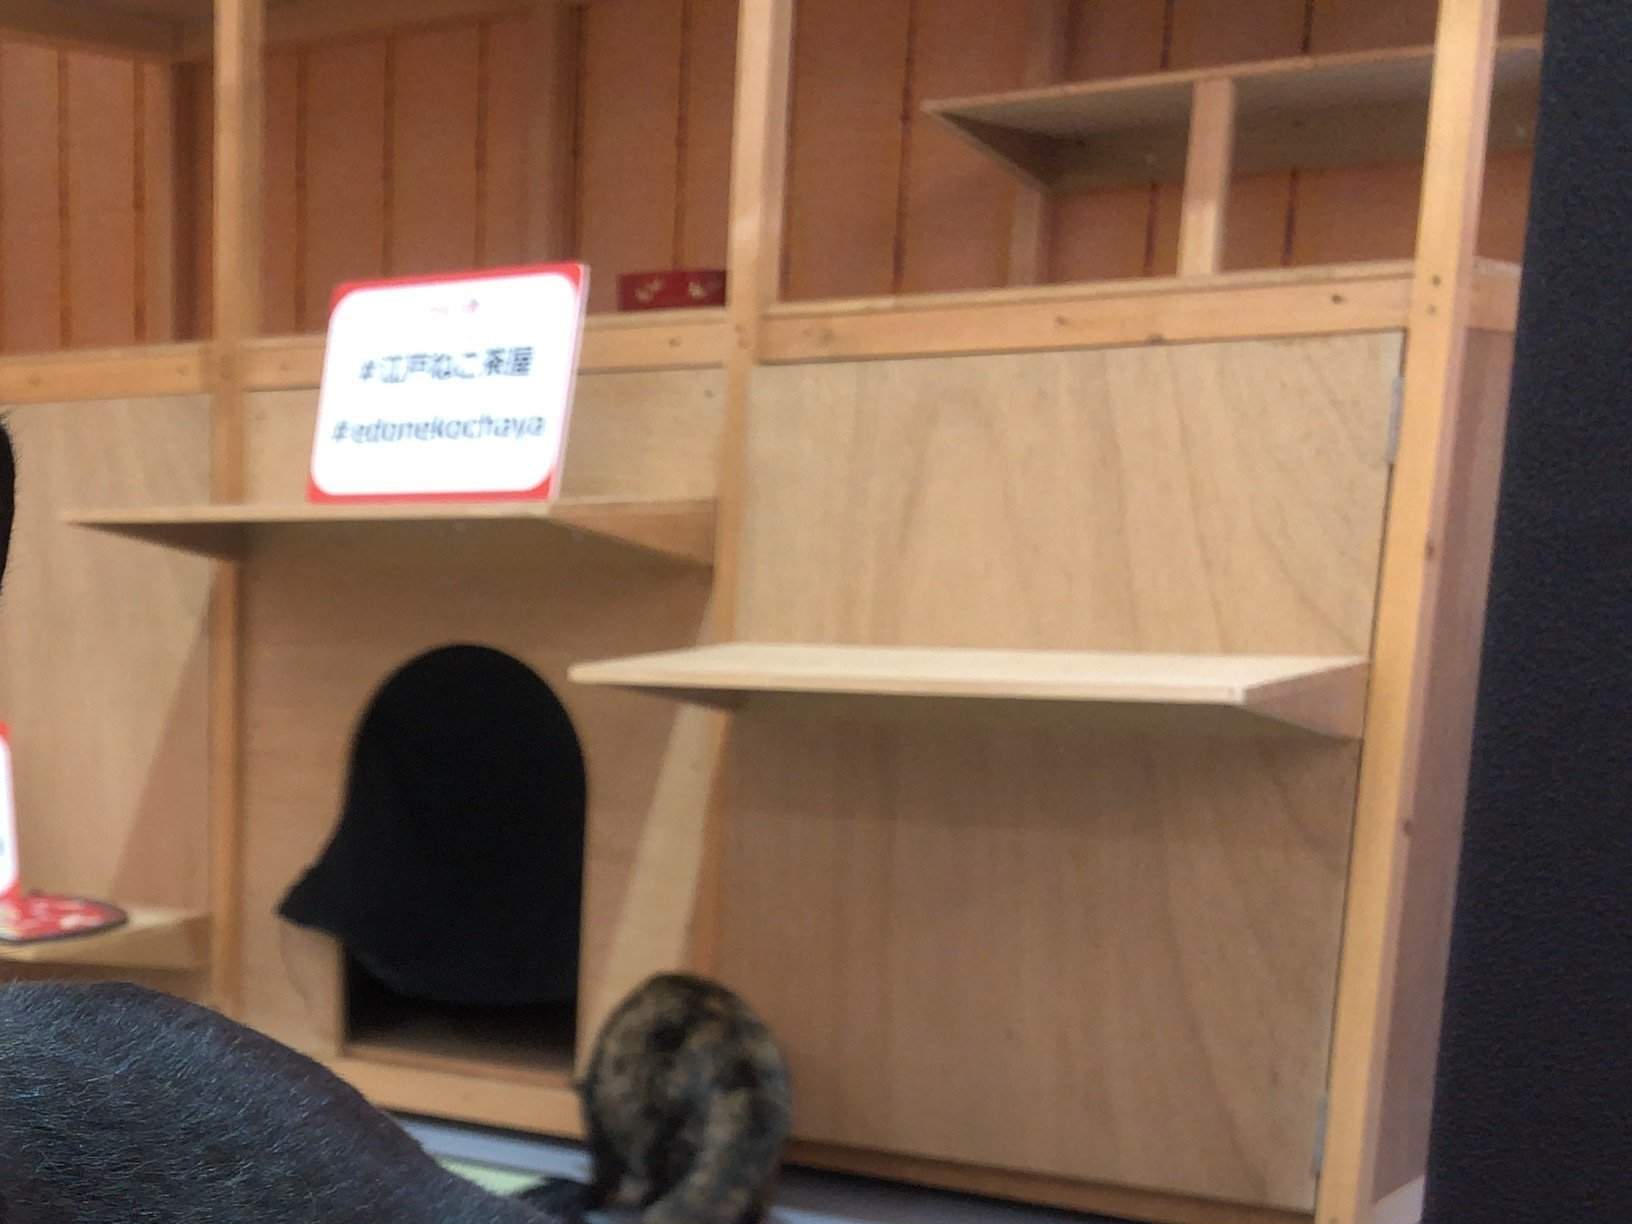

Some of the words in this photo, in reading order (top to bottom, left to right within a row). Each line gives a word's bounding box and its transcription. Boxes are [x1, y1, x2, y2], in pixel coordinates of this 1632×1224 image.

[357, 346, 534, 384] #江戸ねこ茶屋
